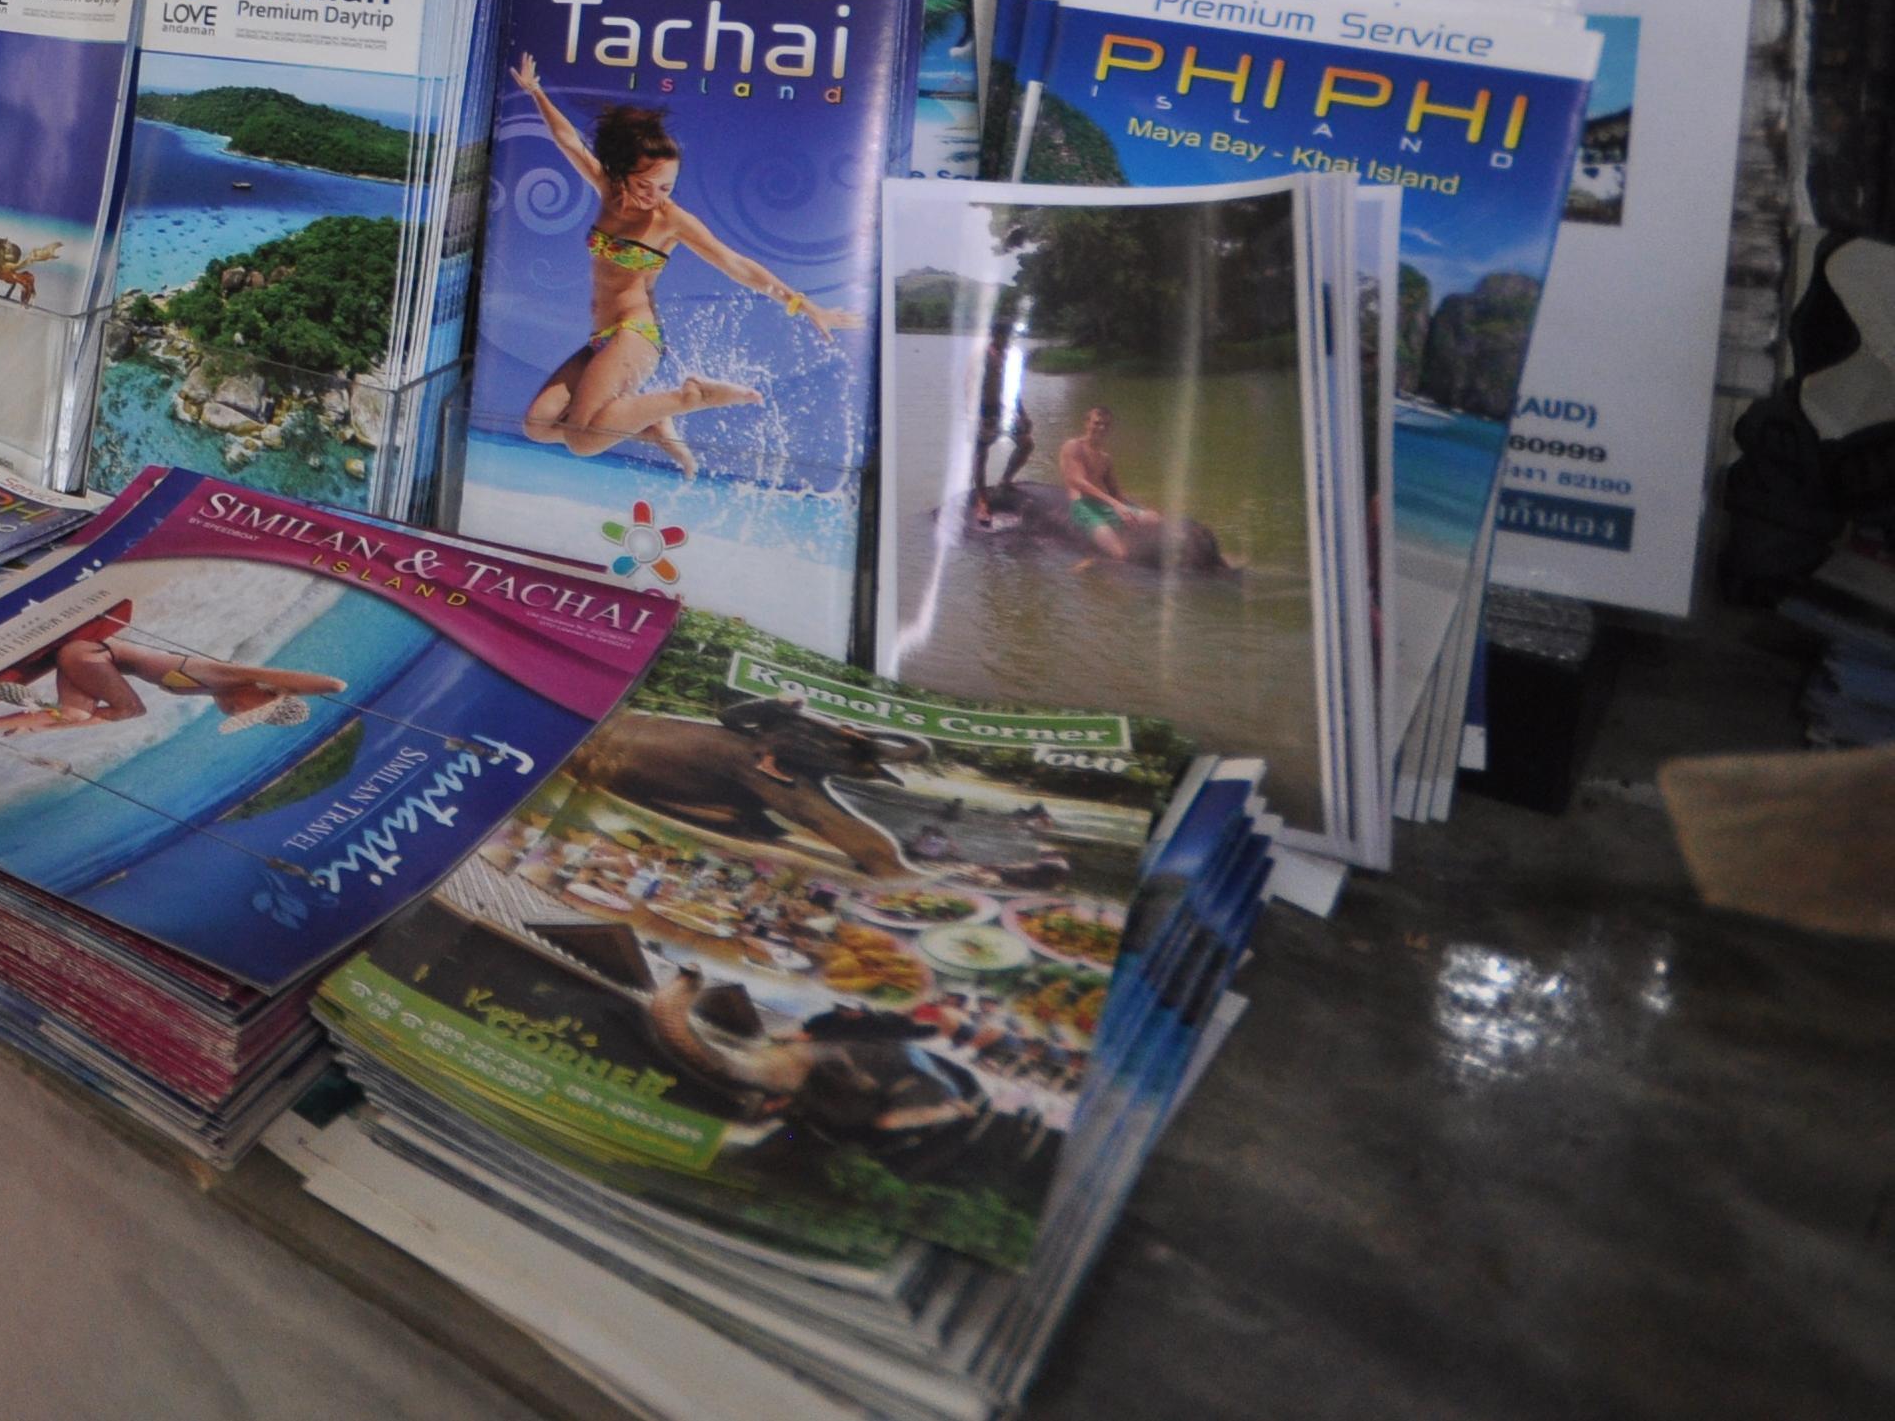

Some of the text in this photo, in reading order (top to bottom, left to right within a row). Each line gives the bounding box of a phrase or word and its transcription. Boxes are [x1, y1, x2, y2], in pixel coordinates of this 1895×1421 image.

[162, 22, 216, 37] andaman
[163, 3, 218, 26] LOVE
[237, 0, 394, 31] Premium Daytrip
[1341, 13, 1494, 58] Service
[1095, 33, 1528, 150] PHI PHI
[1091, 85, 1514, 170] ISLAND
[1126, 117, 1201, 148] Maya
[1210, 132, 1264, 160] Bay
[1291, 148, 1359, 175] Khai
[1368, 159, 1460, 196] Island
[204, 519, 261, 542] SPEEDBOAT
[199, 492, 653, 636] SIMILAN & TACHAI
[311, 554, 469, 608] ISLAND
[746, 663, 1111, 742] Komol's Corner
[283, 746, 429, 851] SIMILAN TRAVEL
